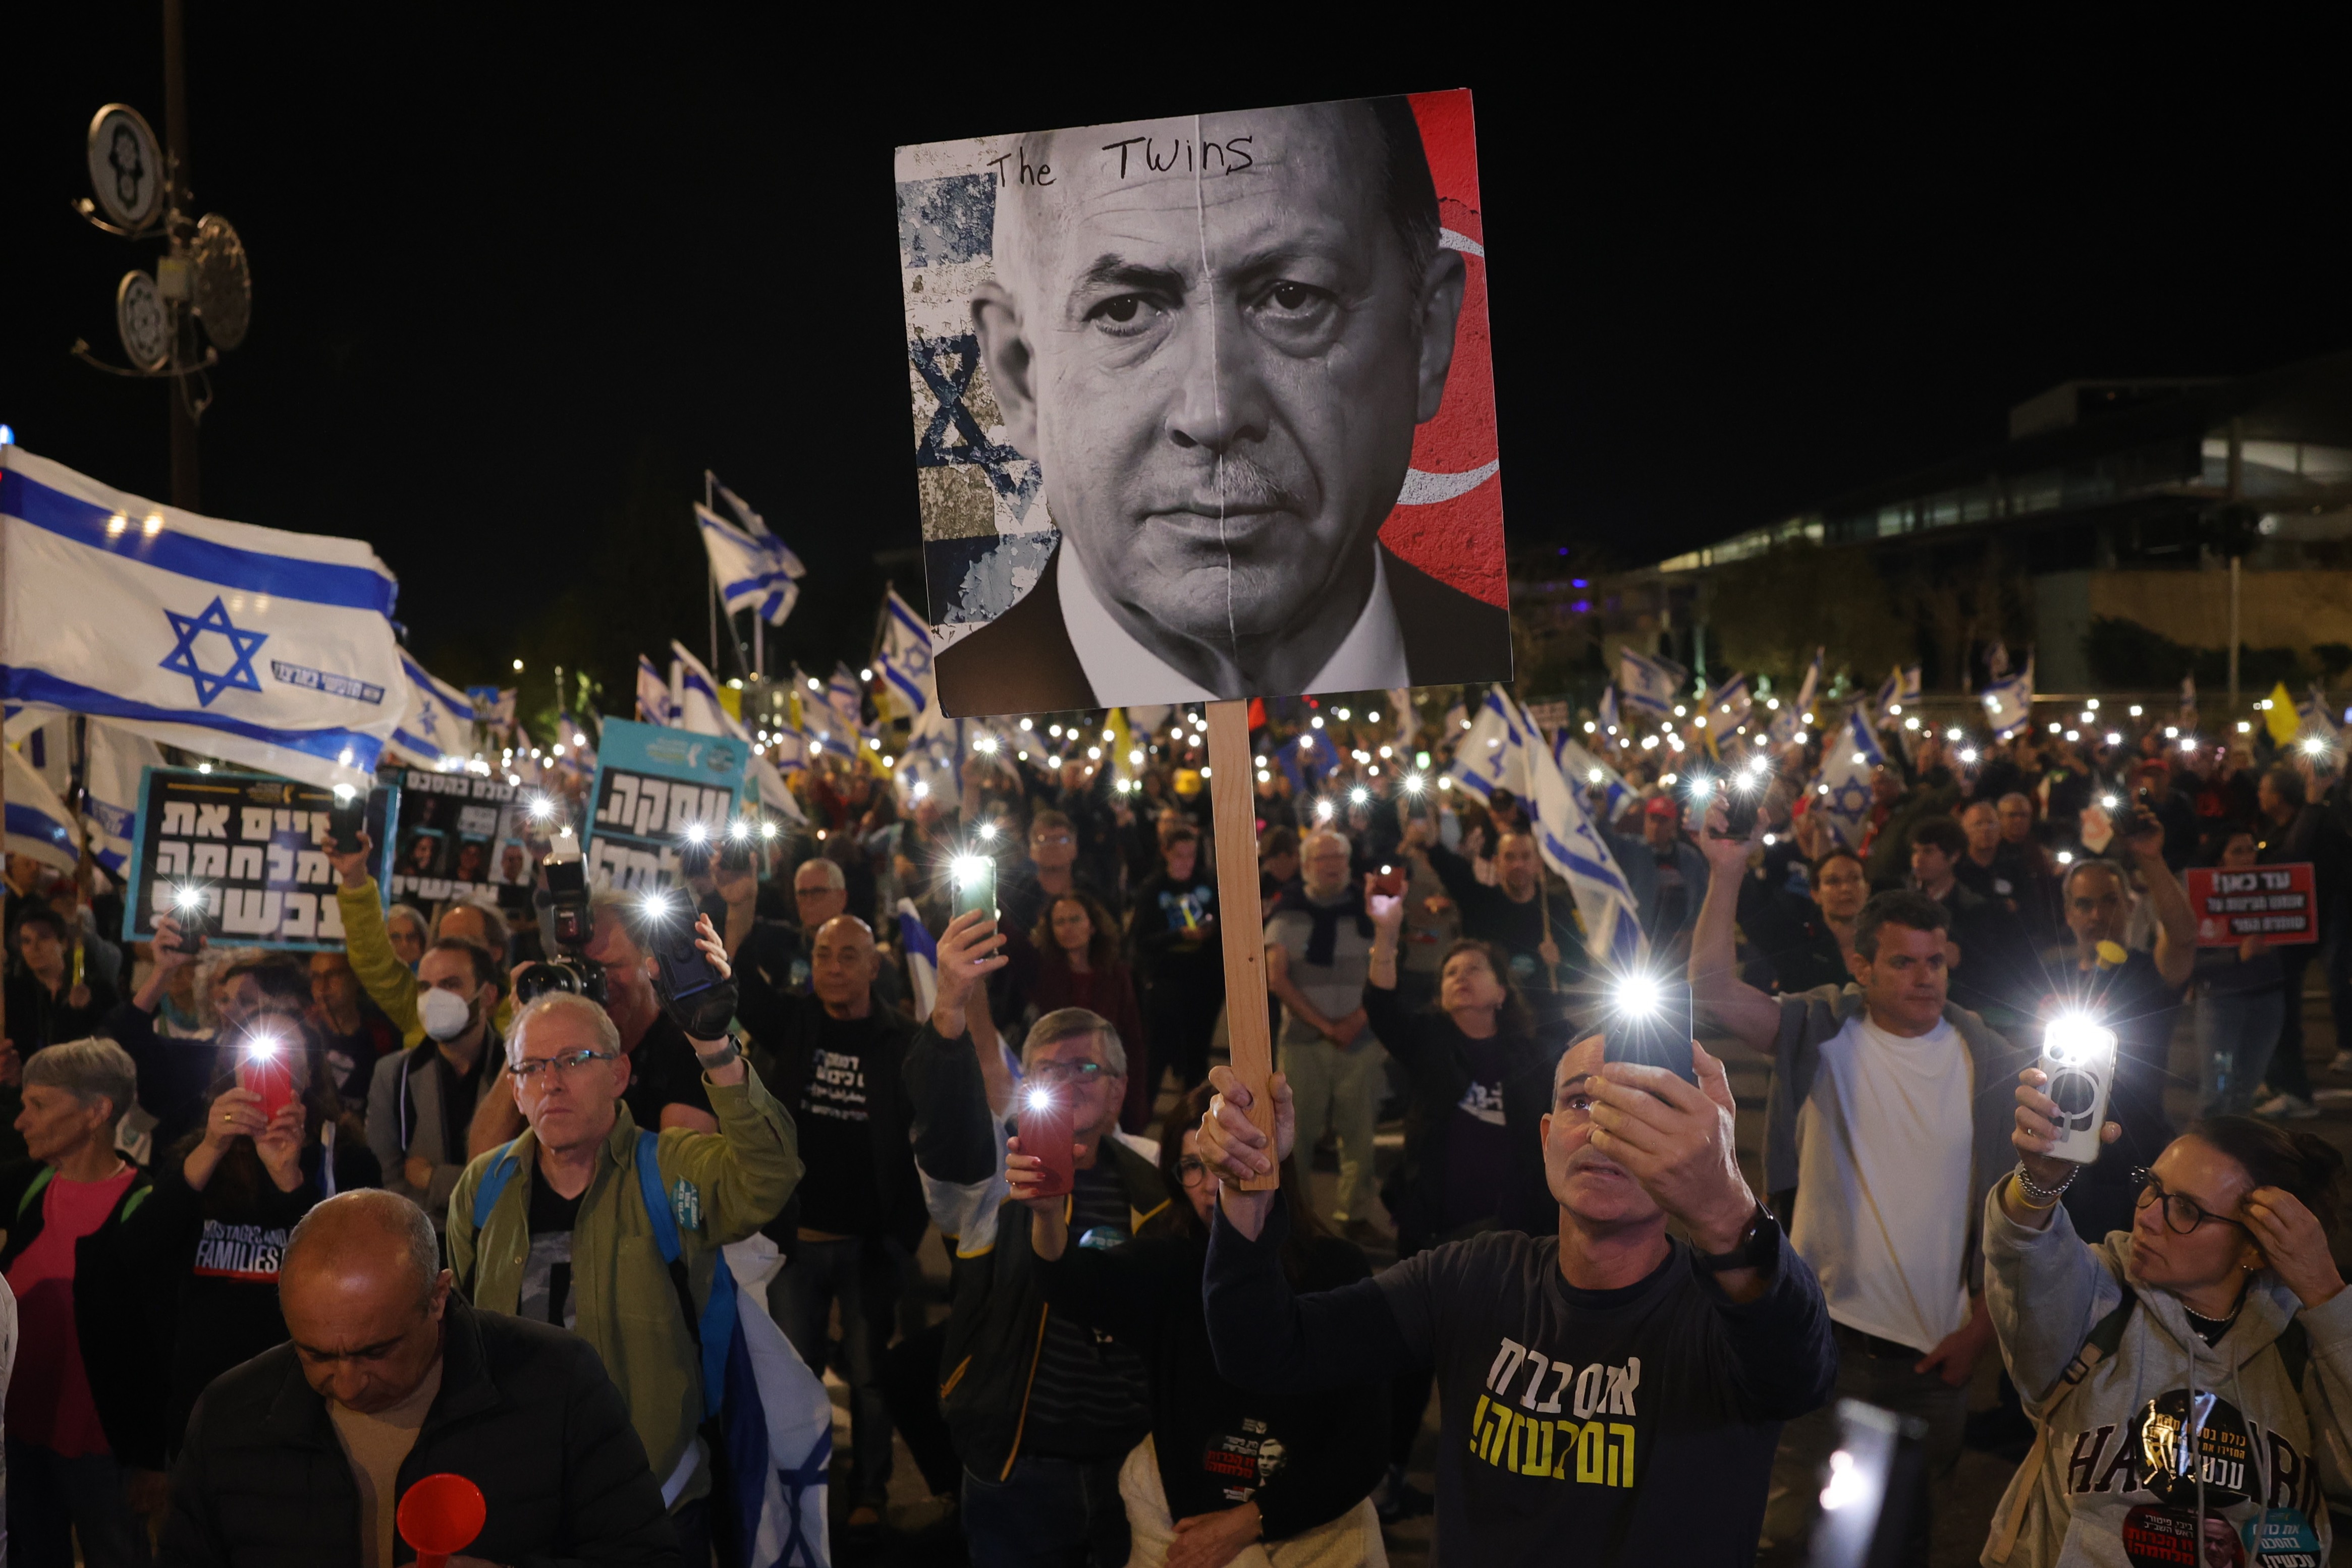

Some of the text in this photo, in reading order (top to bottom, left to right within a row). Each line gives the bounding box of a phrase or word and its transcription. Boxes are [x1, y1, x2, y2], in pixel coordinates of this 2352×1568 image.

[987, 146, 1058, 188] The
[160, 801, 230, 838] את
[156, 840, 343, 885] מלחמה
[263, 1227, 288, 1248] AND
[195, 1239, 278, 1274] FAMILIES
[2202, 1442, 2214, 1452] את
[2220, 1431, 2247, 1447] כולם
[2145, 1515, 2172, 1526] פיטורי
[2282, 1525, 2300, 1535] את
[2127, 1527, 2194, 1551] זו הכרזת
[2174, 1528, 2194, 1538] ראש
[2127, 1539, 2195, 1566] מלחמה!
